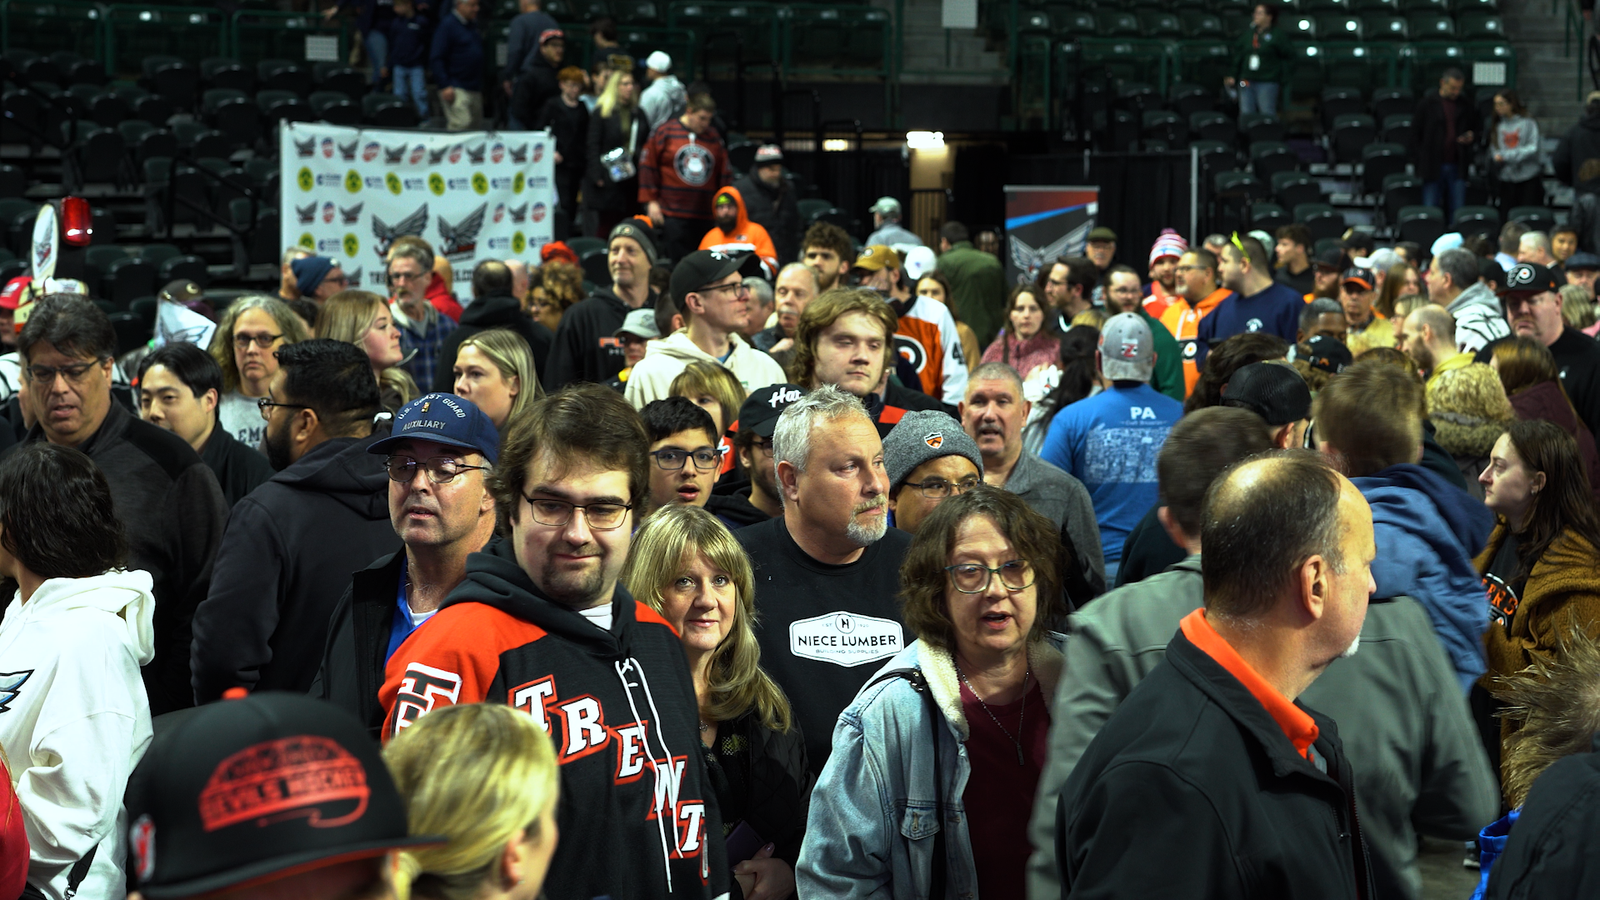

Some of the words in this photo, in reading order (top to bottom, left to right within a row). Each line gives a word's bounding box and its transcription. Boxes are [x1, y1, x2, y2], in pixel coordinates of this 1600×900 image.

[398, 406, 412, 420] U.S.
[442, 398, 466, 419] GUARD
[1130, 406, 1156, 420] PA
[402, 420, 446, 431] AUXILIARY
[841, 618, 849, 629] N
[798, 635, 837, 647] NIECE
[841, 635, 896, 647] LUMBER
